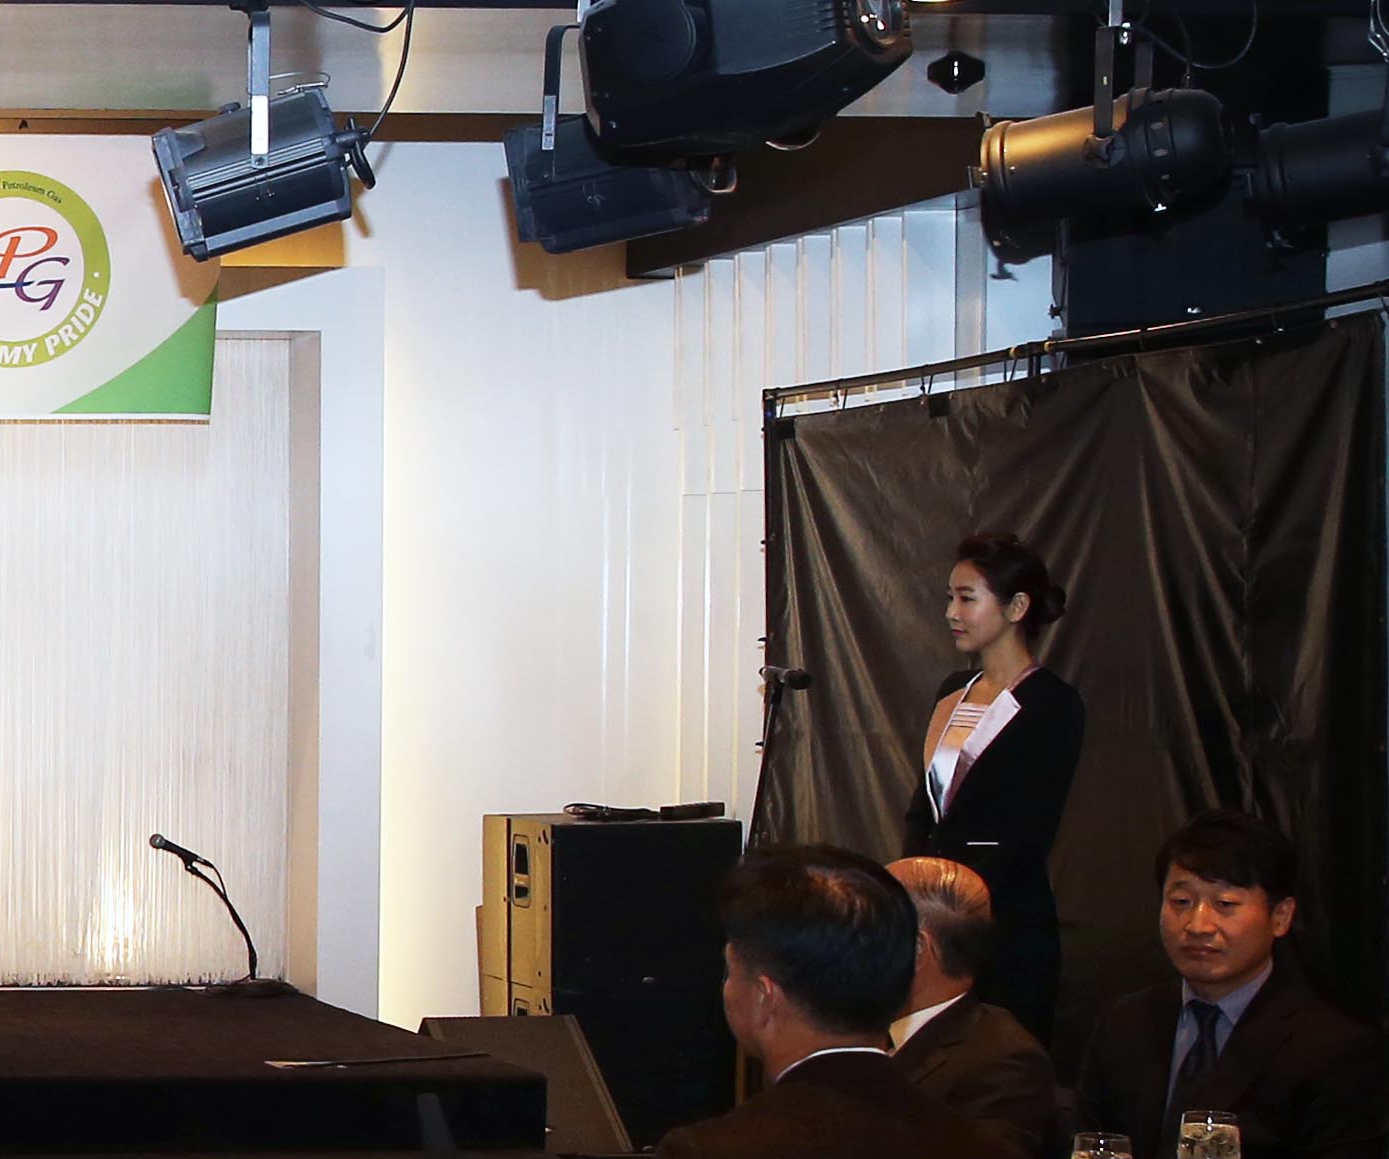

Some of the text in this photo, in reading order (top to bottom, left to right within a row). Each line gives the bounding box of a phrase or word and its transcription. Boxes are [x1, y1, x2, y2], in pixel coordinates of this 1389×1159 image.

[1, 180, 46, 196] Petroleum
[46, 188, 63, 205] Gas
[43, 288, 104, 357] PRIDE
